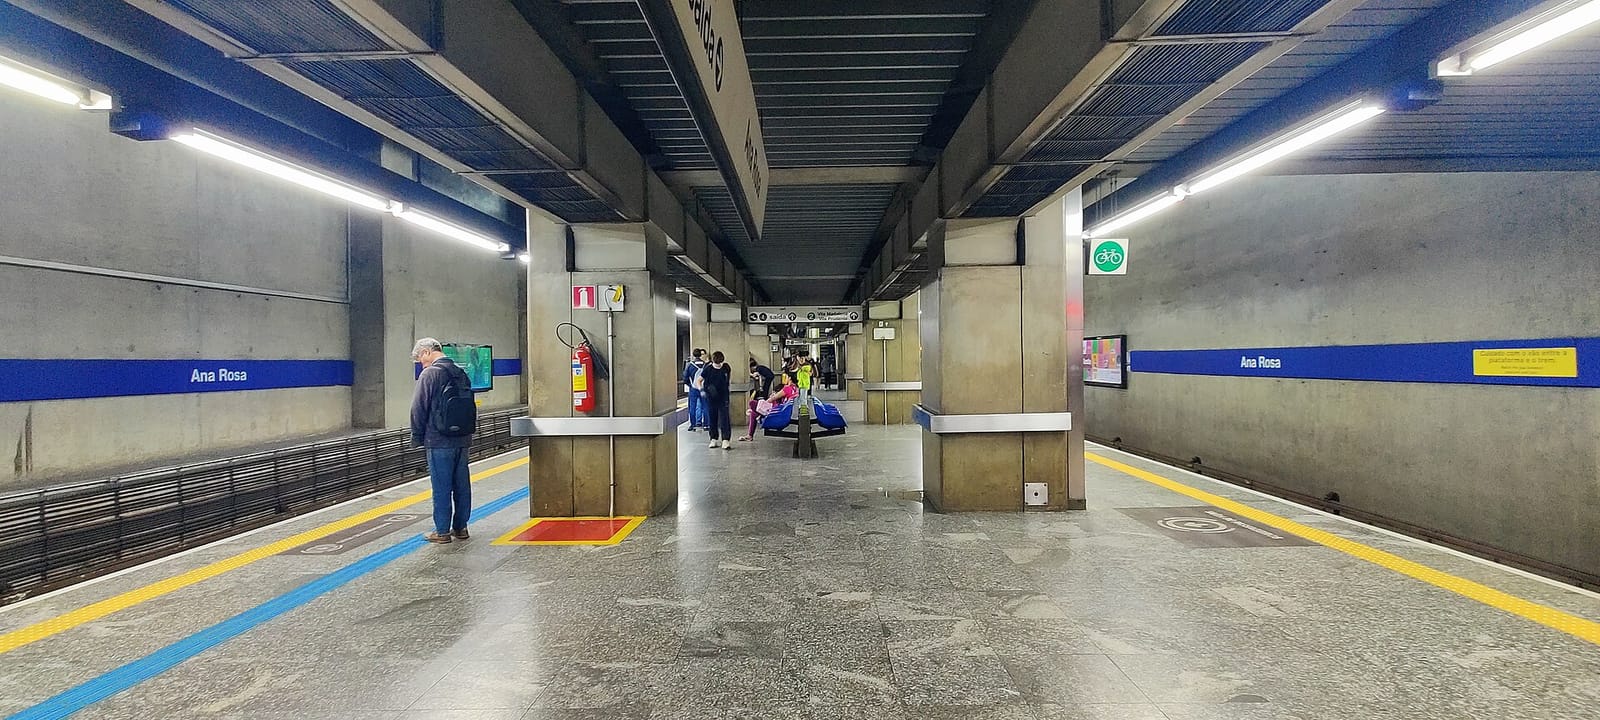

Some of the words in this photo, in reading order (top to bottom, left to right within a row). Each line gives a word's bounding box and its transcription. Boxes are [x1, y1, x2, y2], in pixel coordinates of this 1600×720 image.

[1240, 356, 1257, 368] Ana
[1258, 356, 1281, 368] Rosa
[190, 368, 216, 383] Ana
[218, 368, 248, 382] Rosa
